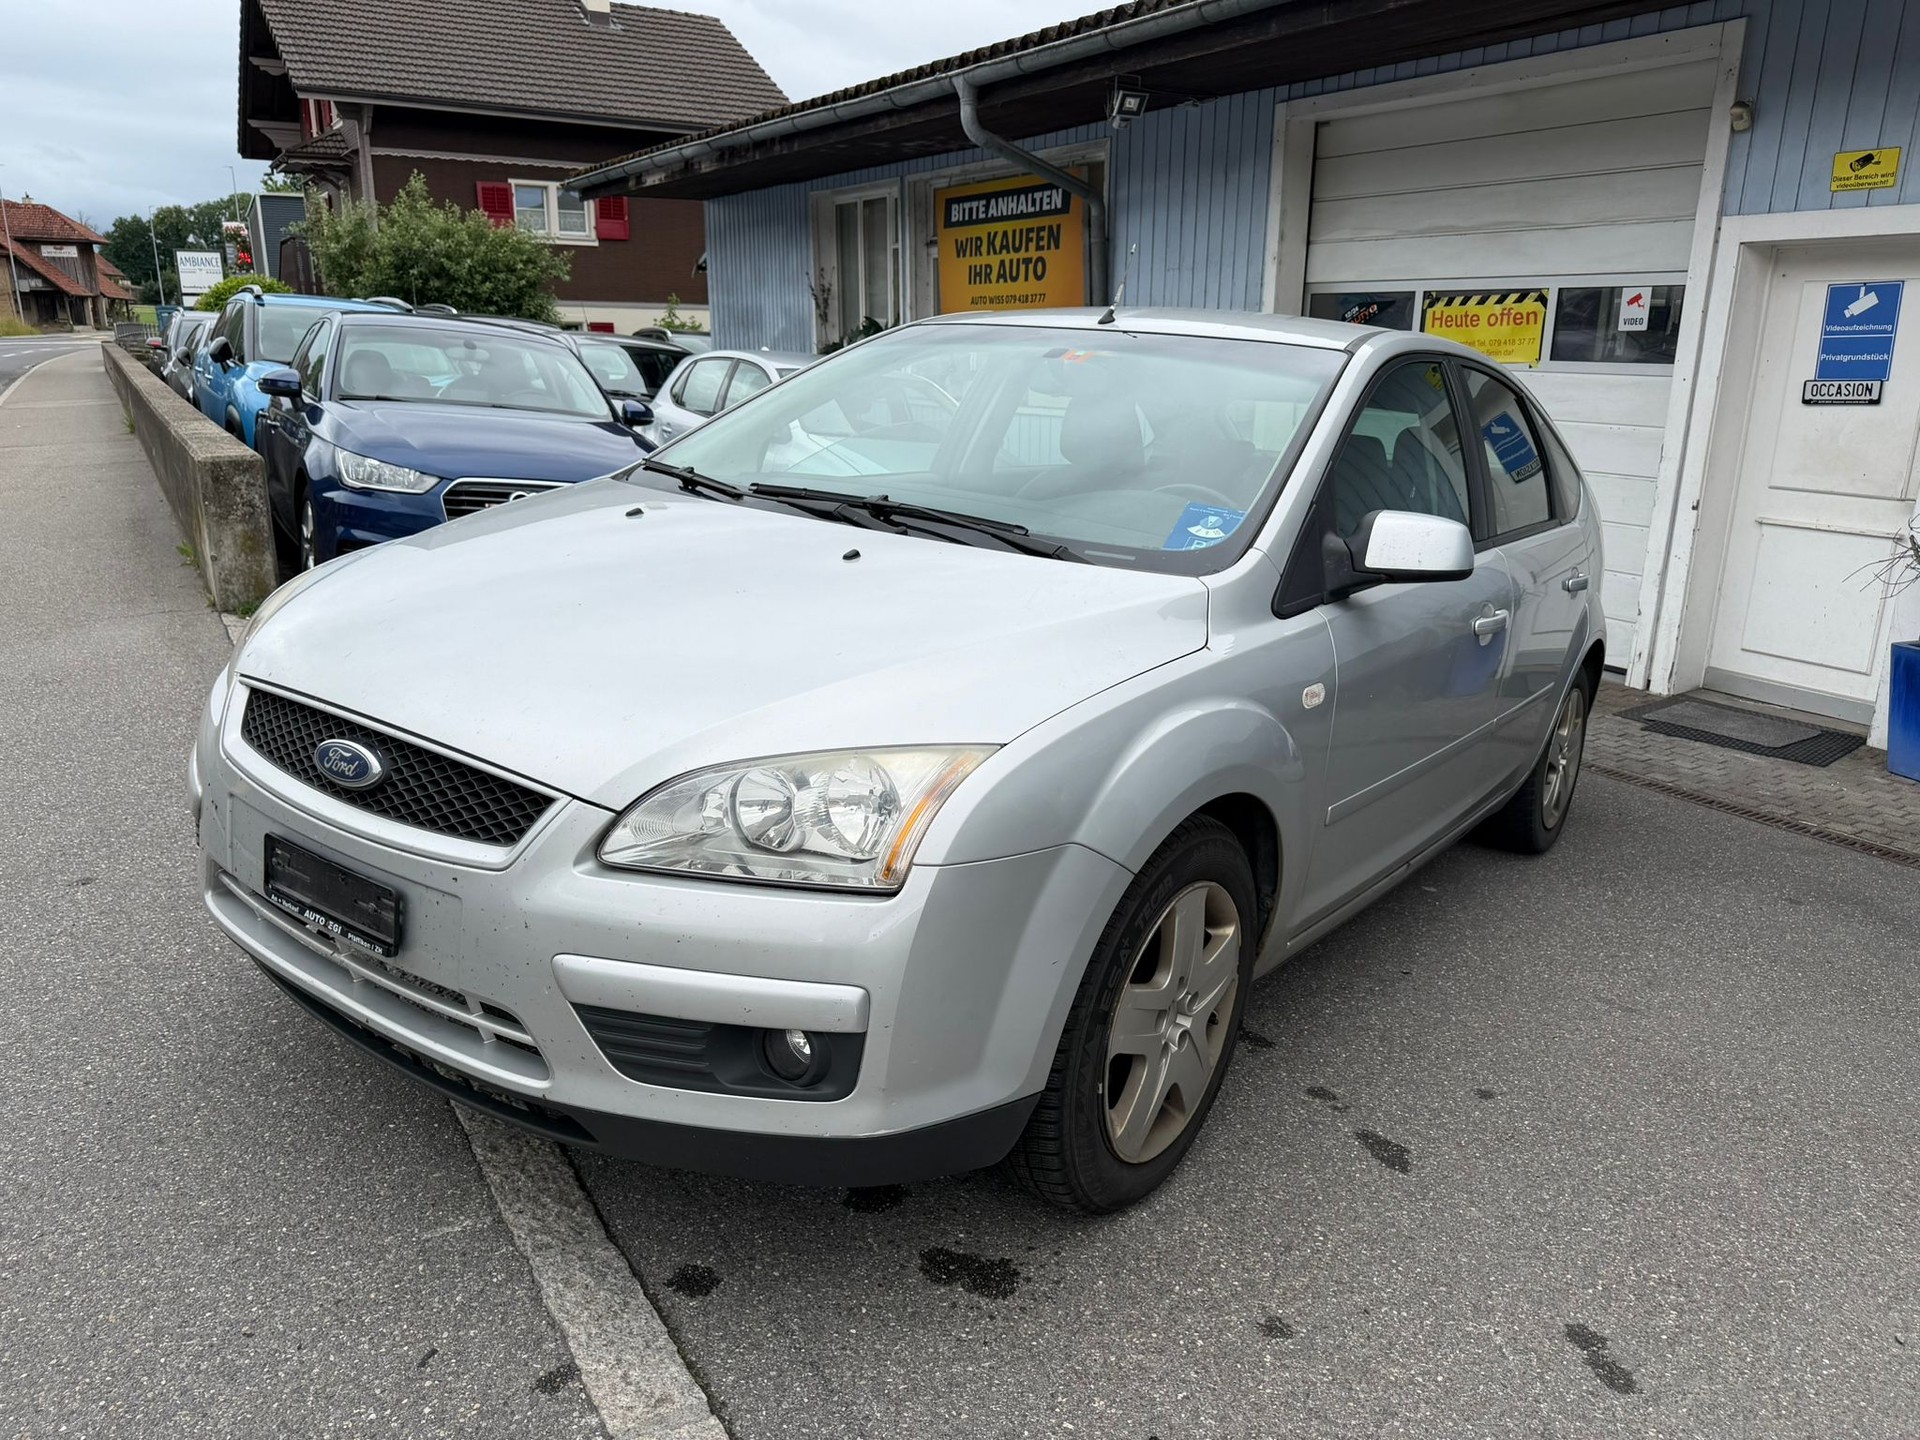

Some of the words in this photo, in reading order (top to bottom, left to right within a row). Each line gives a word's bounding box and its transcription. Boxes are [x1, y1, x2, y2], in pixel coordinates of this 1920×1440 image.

[1836, 179, 1889, 188] videoüberwacht!
[951, 199, 986, 223] BITTE
[987, 188, 1062, 218] ANHALTEN
[954, 236, 983, 258] WIR
[987, 224, 1061, 256] KAUFEN
[180, 256, 220, 268] AMBIANCE
[968, 264, 993, 285] IHR
[995, 256, 1047, 284] AUTO
[971, 296, 987, 305] AUTO
[988, 295, 1004, 305] WISS
[1005, 294, 1017, 304] 079
[1018, 293, 1029, 303] 418
[1030, 293, 1037, 303] 37
[1038, 293, 1046, 303] 77
[1431, 310, 1480, 329] Heute
[1487, 307, 1539, 327] offen
[1623, 317, 1644, 326] VIDEO
[1825, 323, 1892, 332] Videoaufzeichnung
[1488, 339, 1501, 347] 079
[1820, 353, 1888, 362] Privatgrundstück
[1811, 383, 1873, 397] OCCASION
[324, 747, 359, 777] Ford
[304, 909, 325, 925] AUTO
